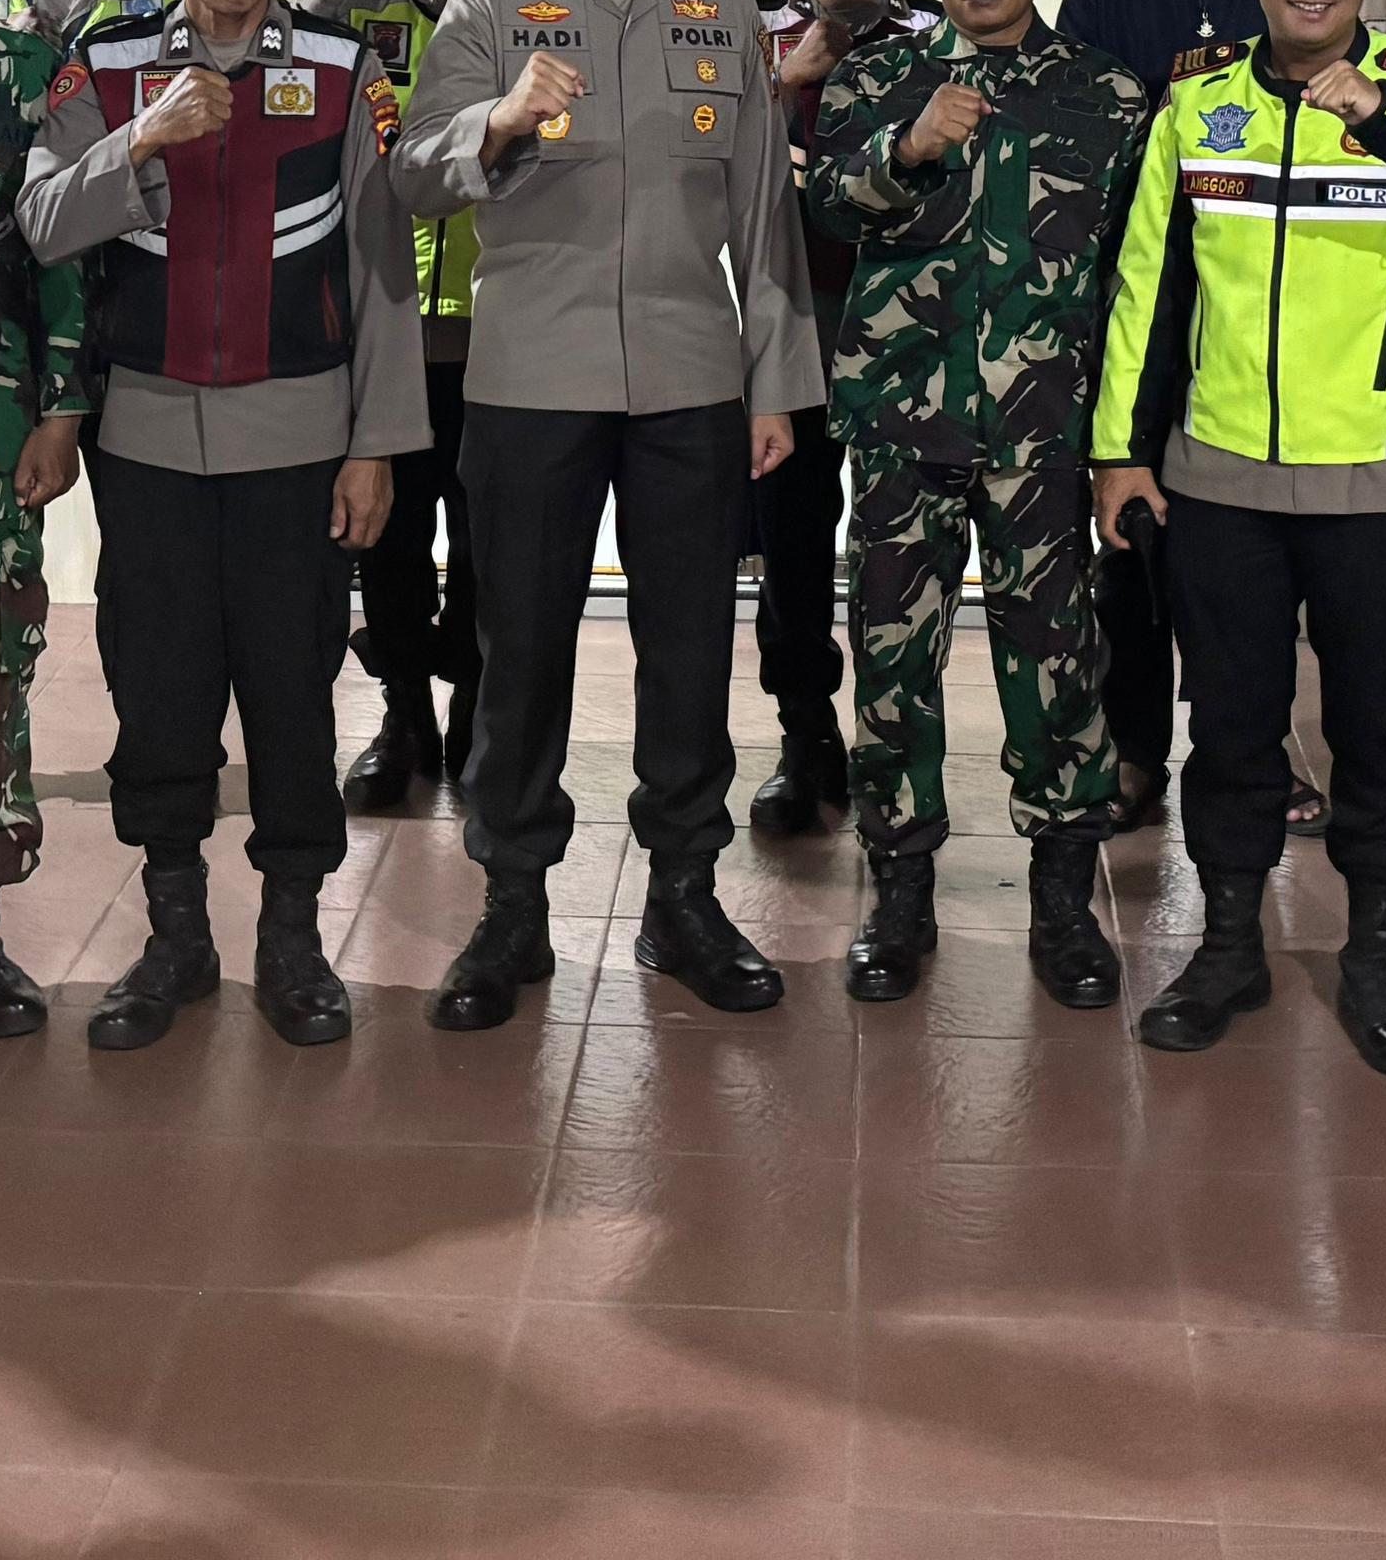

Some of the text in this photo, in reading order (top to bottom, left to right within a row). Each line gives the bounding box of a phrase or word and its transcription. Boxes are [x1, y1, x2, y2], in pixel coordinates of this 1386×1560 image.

[513, 29, 582, 48] HADI
[671, 27, 733, 48] POLRI
[1189, 175, 1245, 196] ANGGORO
